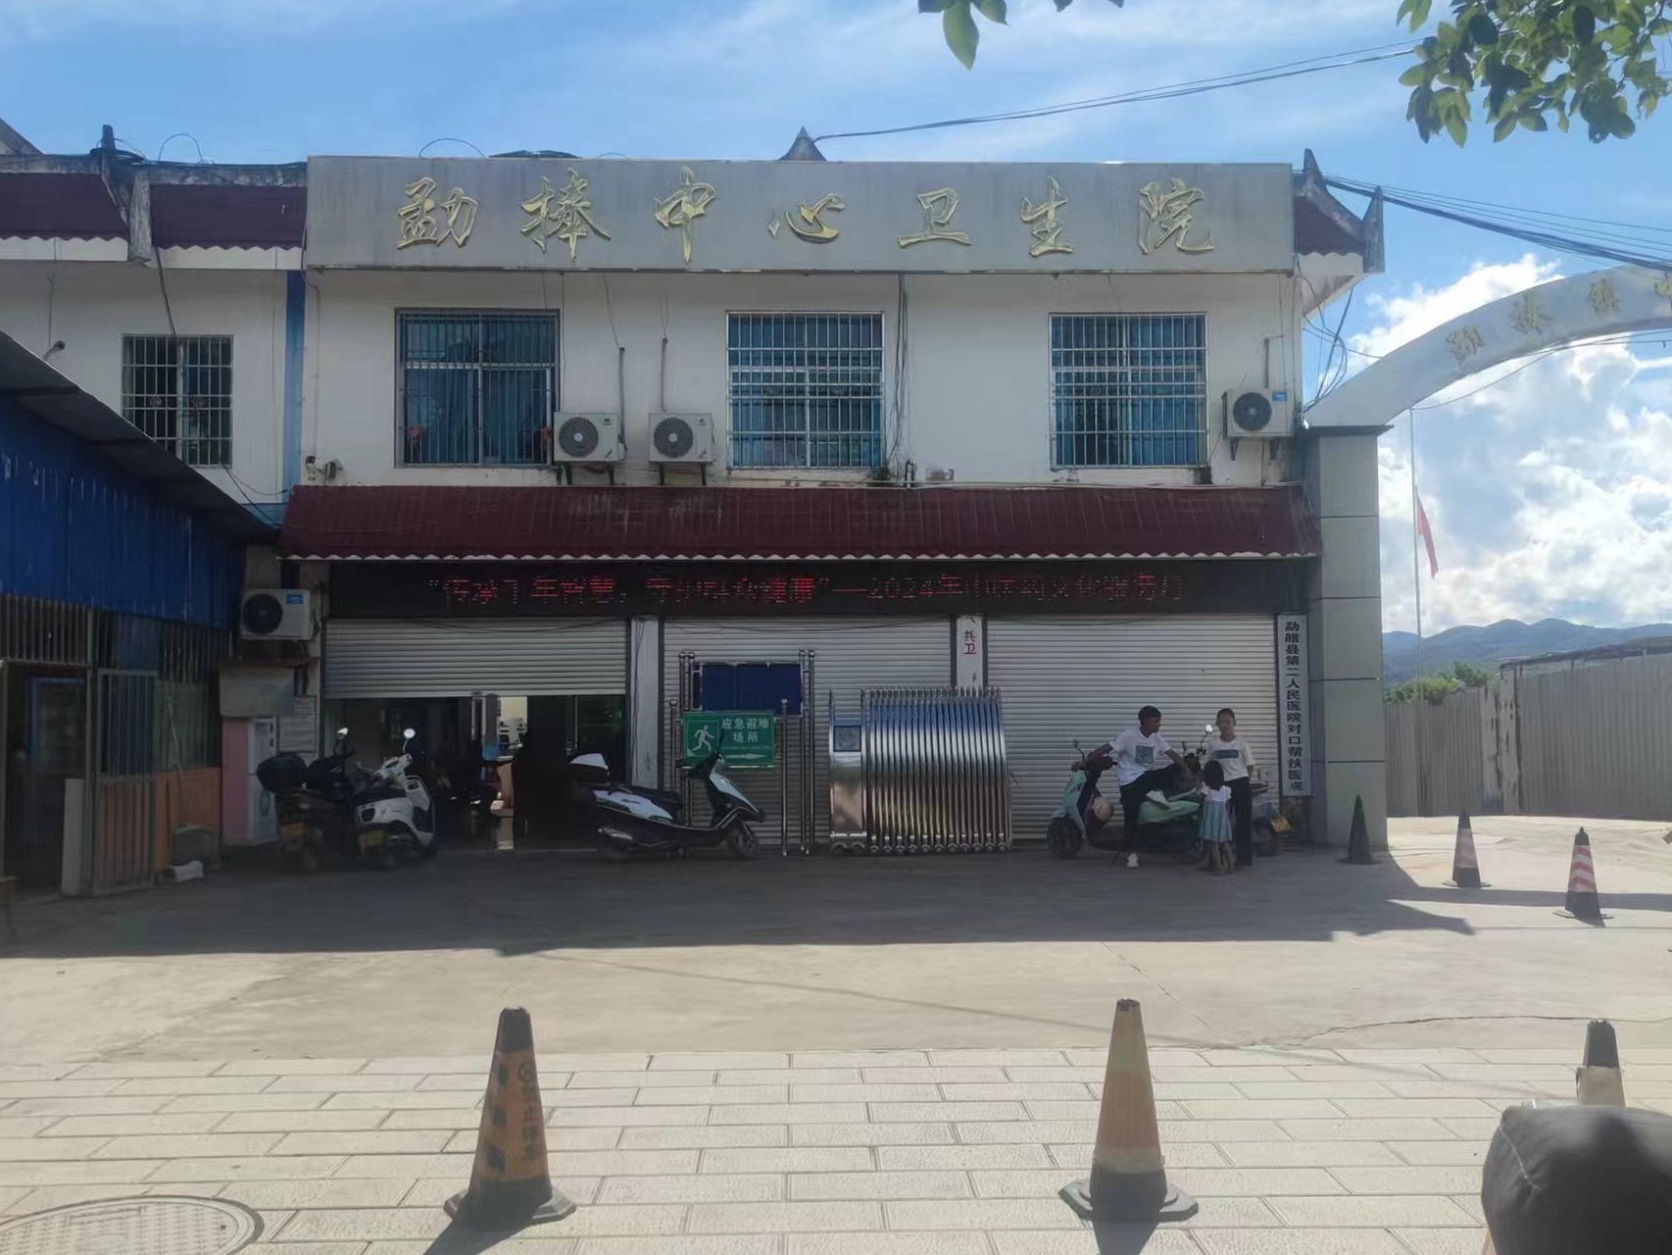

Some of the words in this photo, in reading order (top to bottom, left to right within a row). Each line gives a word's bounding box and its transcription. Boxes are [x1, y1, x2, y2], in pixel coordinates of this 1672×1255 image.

[721, 717, 770, 730] 应急避难
[732, 731, 759, 743] 场所
